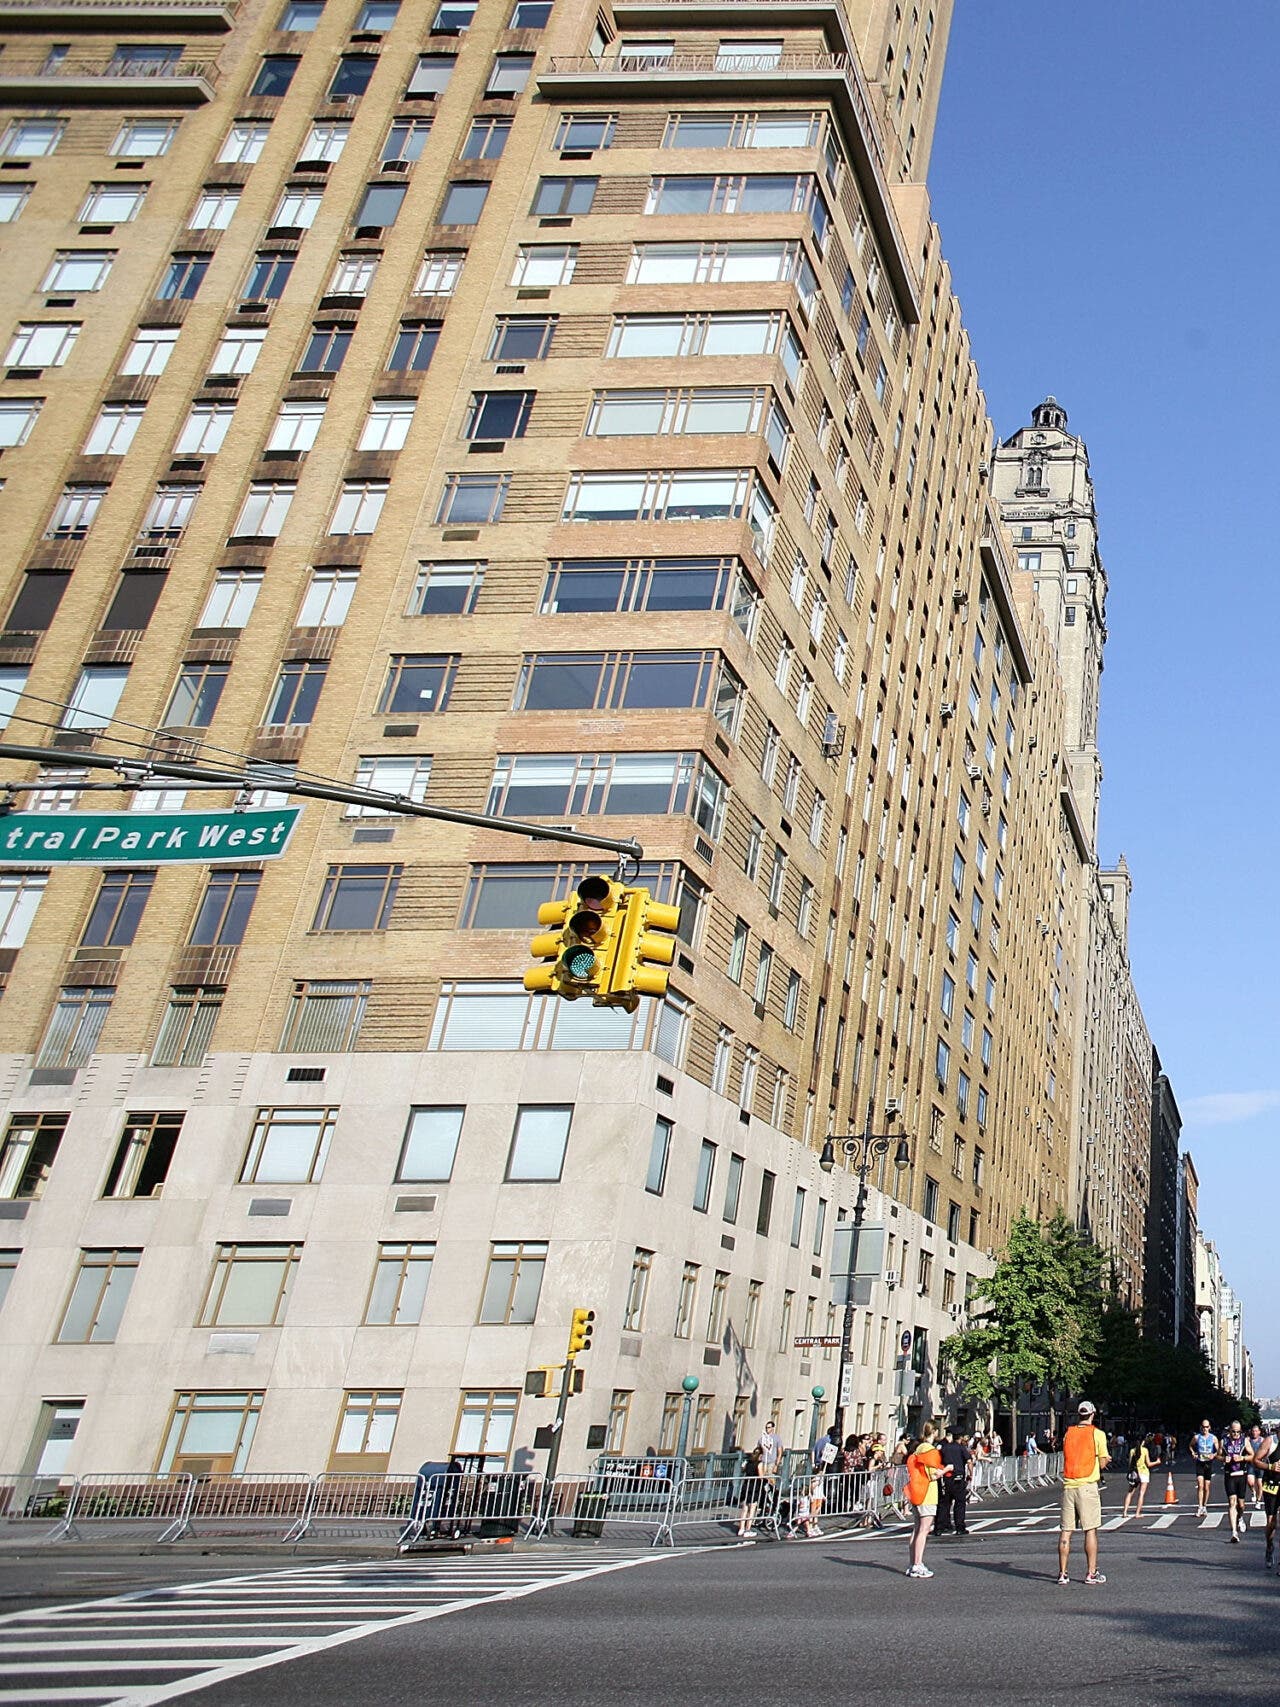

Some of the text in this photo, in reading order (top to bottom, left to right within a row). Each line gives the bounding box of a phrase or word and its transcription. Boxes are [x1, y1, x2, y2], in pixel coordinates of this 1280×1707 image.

[5, 821, 286, 850] tral Park West
